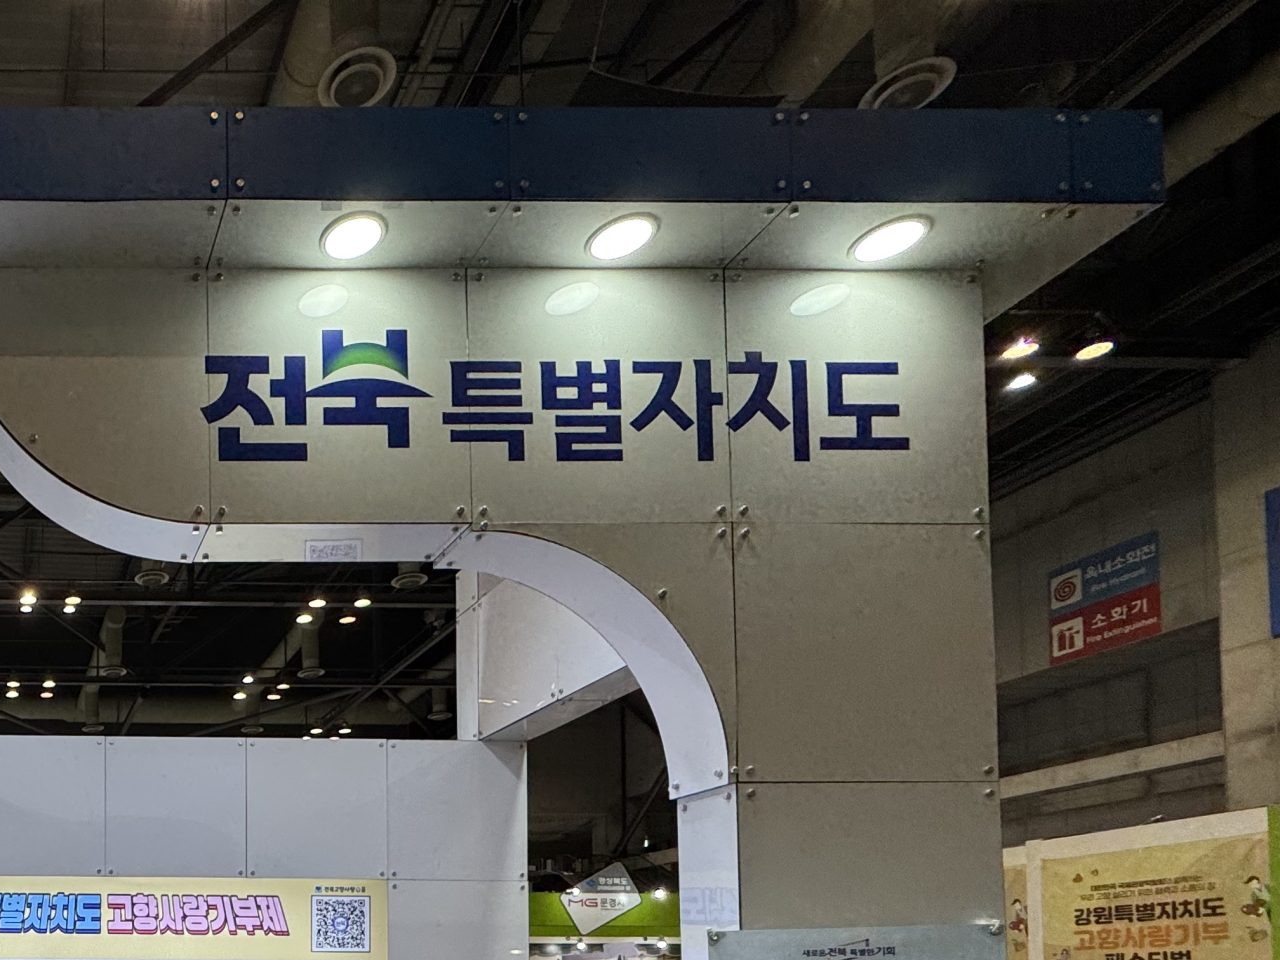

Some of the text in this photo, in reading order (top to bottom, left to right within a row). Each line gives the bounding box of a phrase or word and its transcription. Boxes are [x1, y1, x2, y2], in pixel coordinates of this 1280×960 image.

[1091, 598, 1147, 629] 소화기
[107, 893, 291, 936] 고향사랑기부제
[1074, 897, 1226, 926] 강원특별자치도
[1073, 921, 1230, 950] 고향사랑기부
